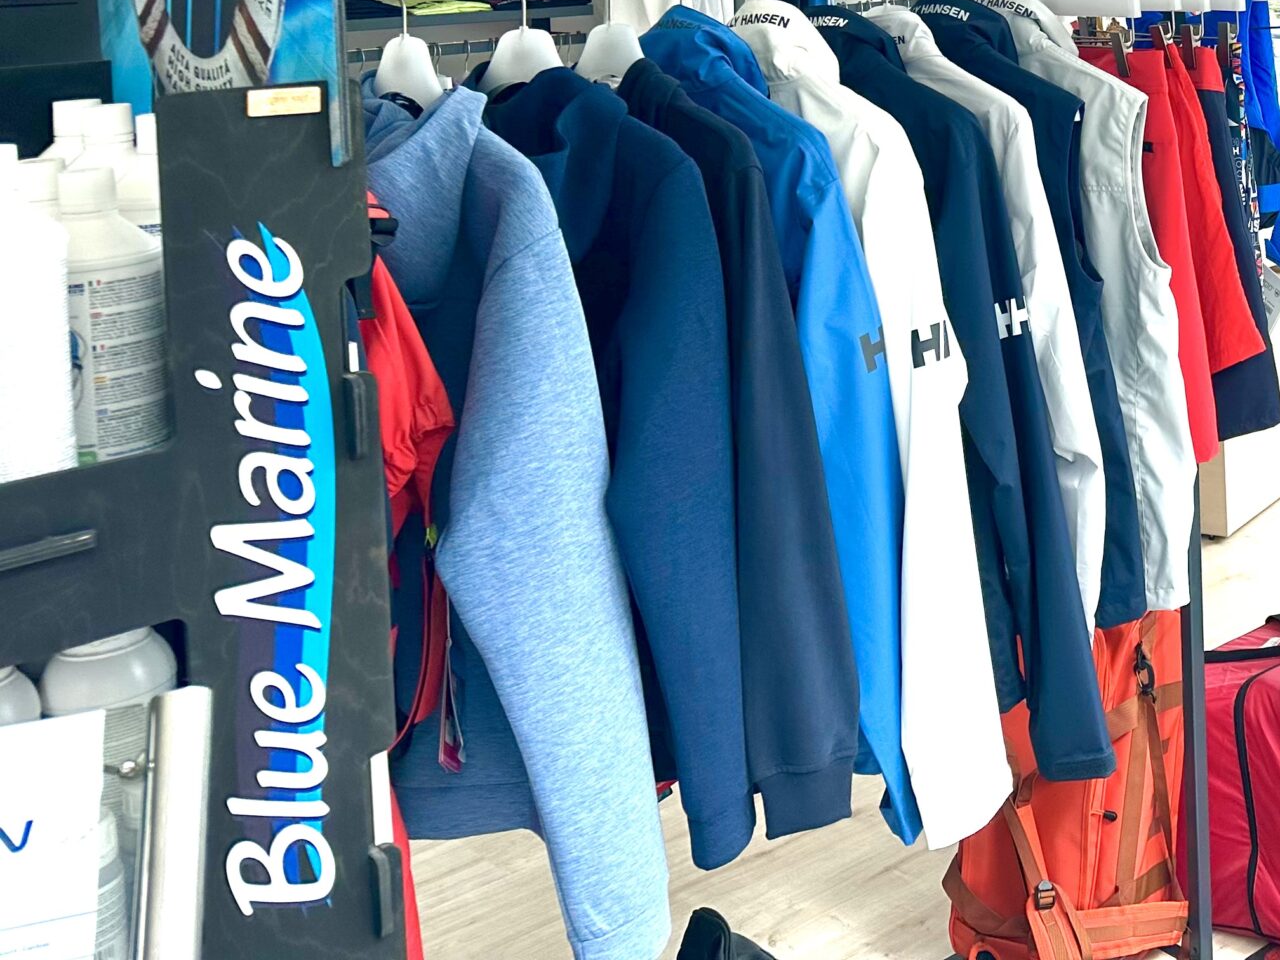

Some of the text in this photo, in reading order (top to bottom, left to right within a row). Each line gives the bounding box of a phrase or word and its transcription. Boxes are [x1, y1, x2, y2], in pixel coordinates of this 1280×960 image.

[740, 13, 790, 29] HANSEN
[920, 3, 970, 22] HANSEN
[168, 55, 191, 89] HIGH
[170, 44, 190, 72] ALTA
[195, 237, 336, 917] Blue Marine
